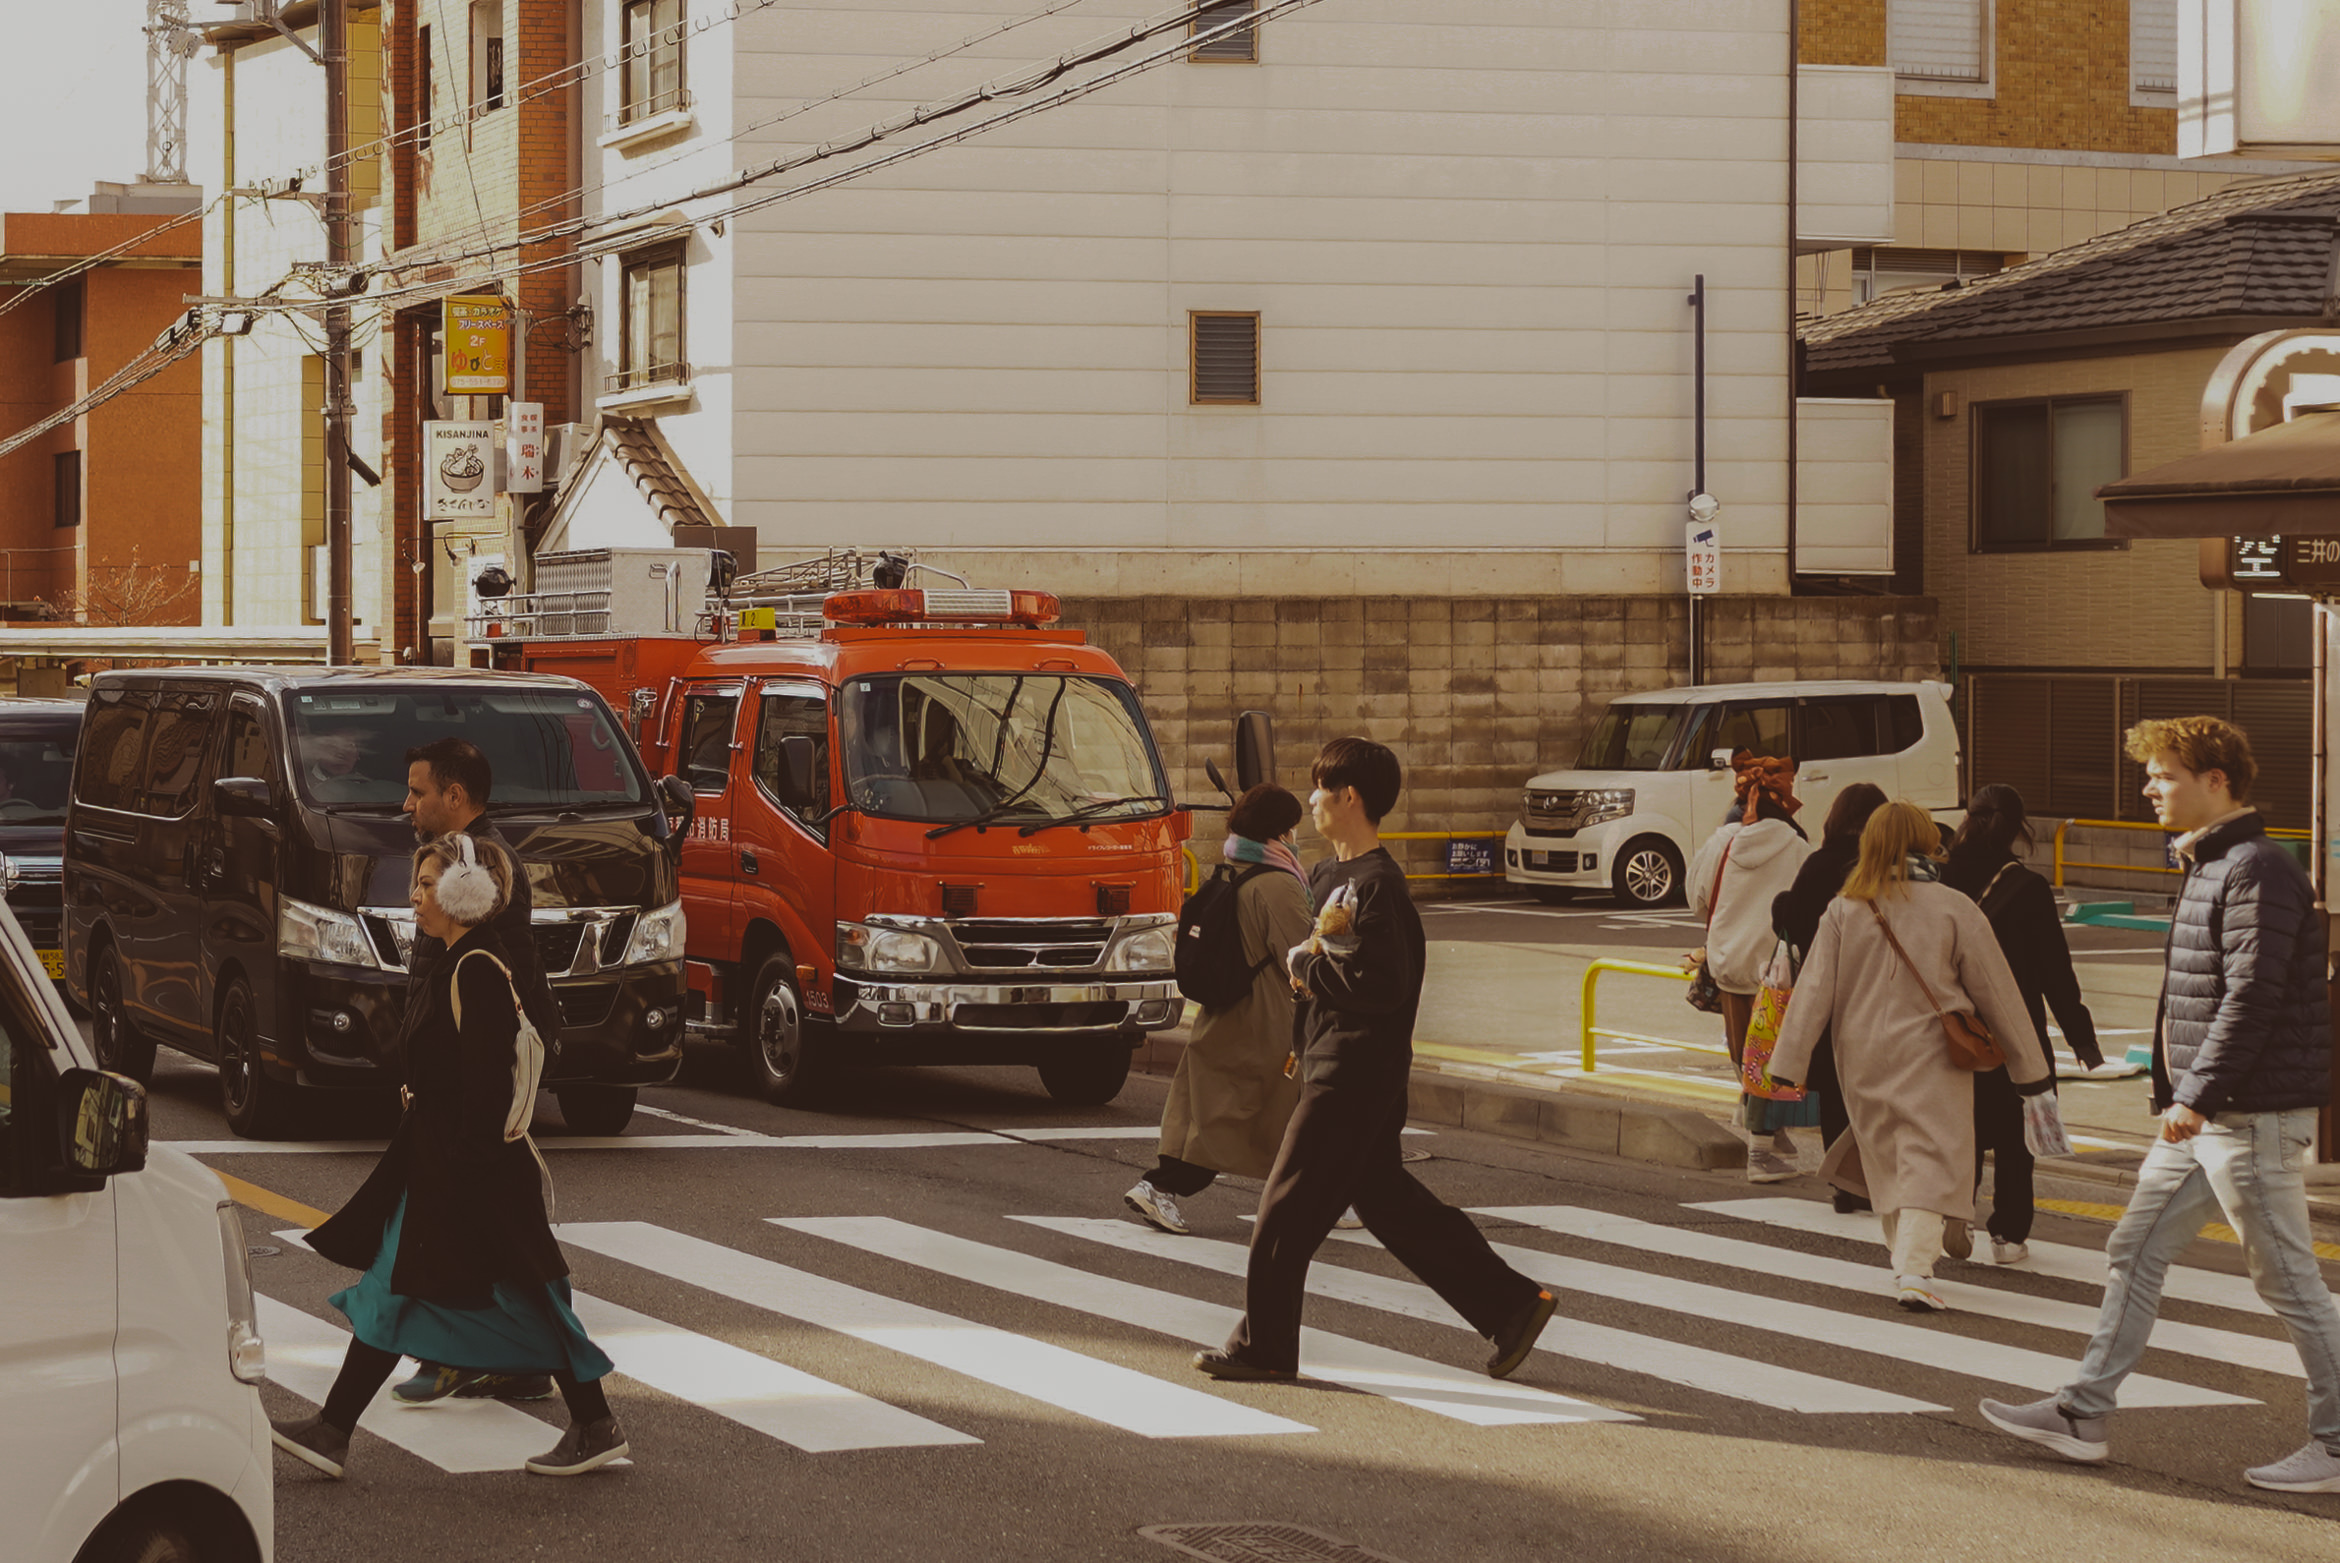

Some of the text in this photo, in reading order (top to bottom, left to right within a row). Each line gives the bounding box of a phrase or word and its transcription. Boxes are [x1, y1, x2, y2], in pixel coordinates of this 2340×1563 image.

[458, 319, 505, 330] フリースペース
[470, 334, 486, 347] 2F
[436, 430, 489, 439] KISANJINA
[2297, 539, 2340, 564] 三井の
[1692, 553, 1702, 588] 作動中
[1705, 553, 1715, 588] カメラ
[806, 990, 829, 1008] 1503
